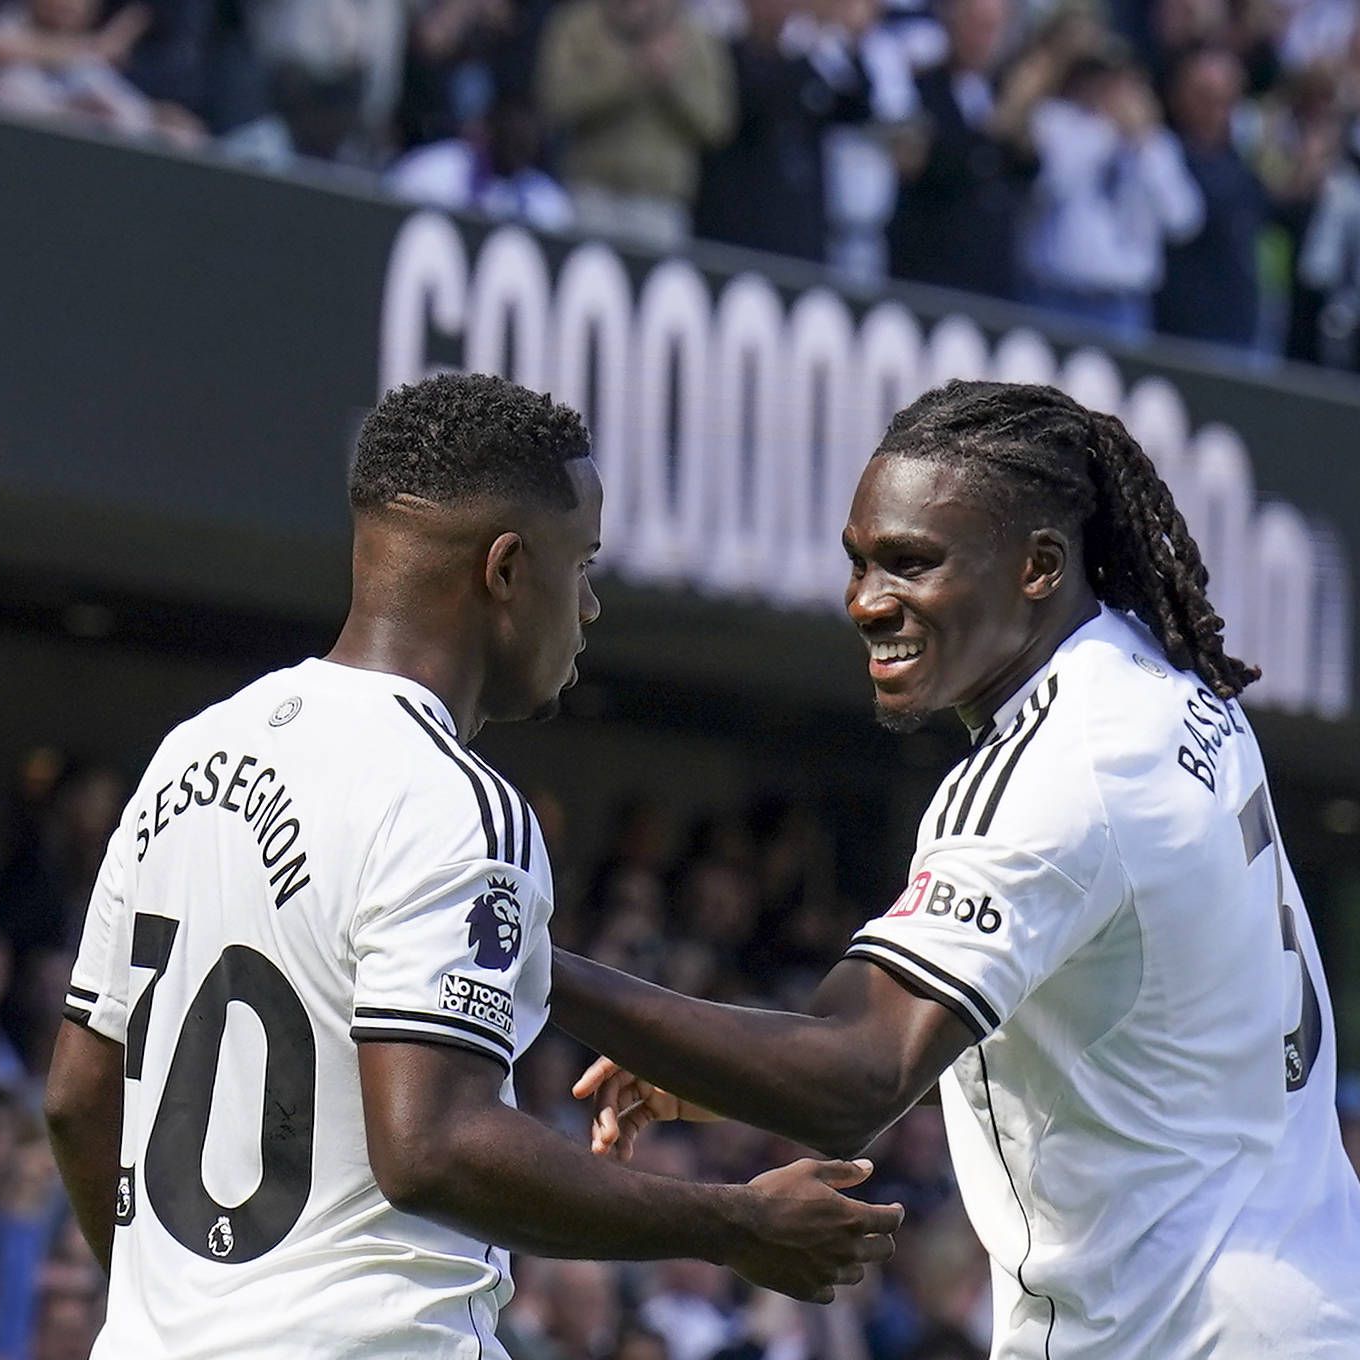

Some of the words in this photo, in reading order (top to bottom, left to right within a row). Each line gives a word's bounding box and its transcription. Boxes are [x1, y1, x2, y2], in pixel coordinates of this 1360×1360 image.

[136, 750, 311, 910] SESSEGNON
[925, 879, 1002, 934] Bob
[439, 990, 468, 1012] for
[468, 999, 514, 1034] racism
[441, 973, 471, 997] No
[472, 984, 512, 1016] room
